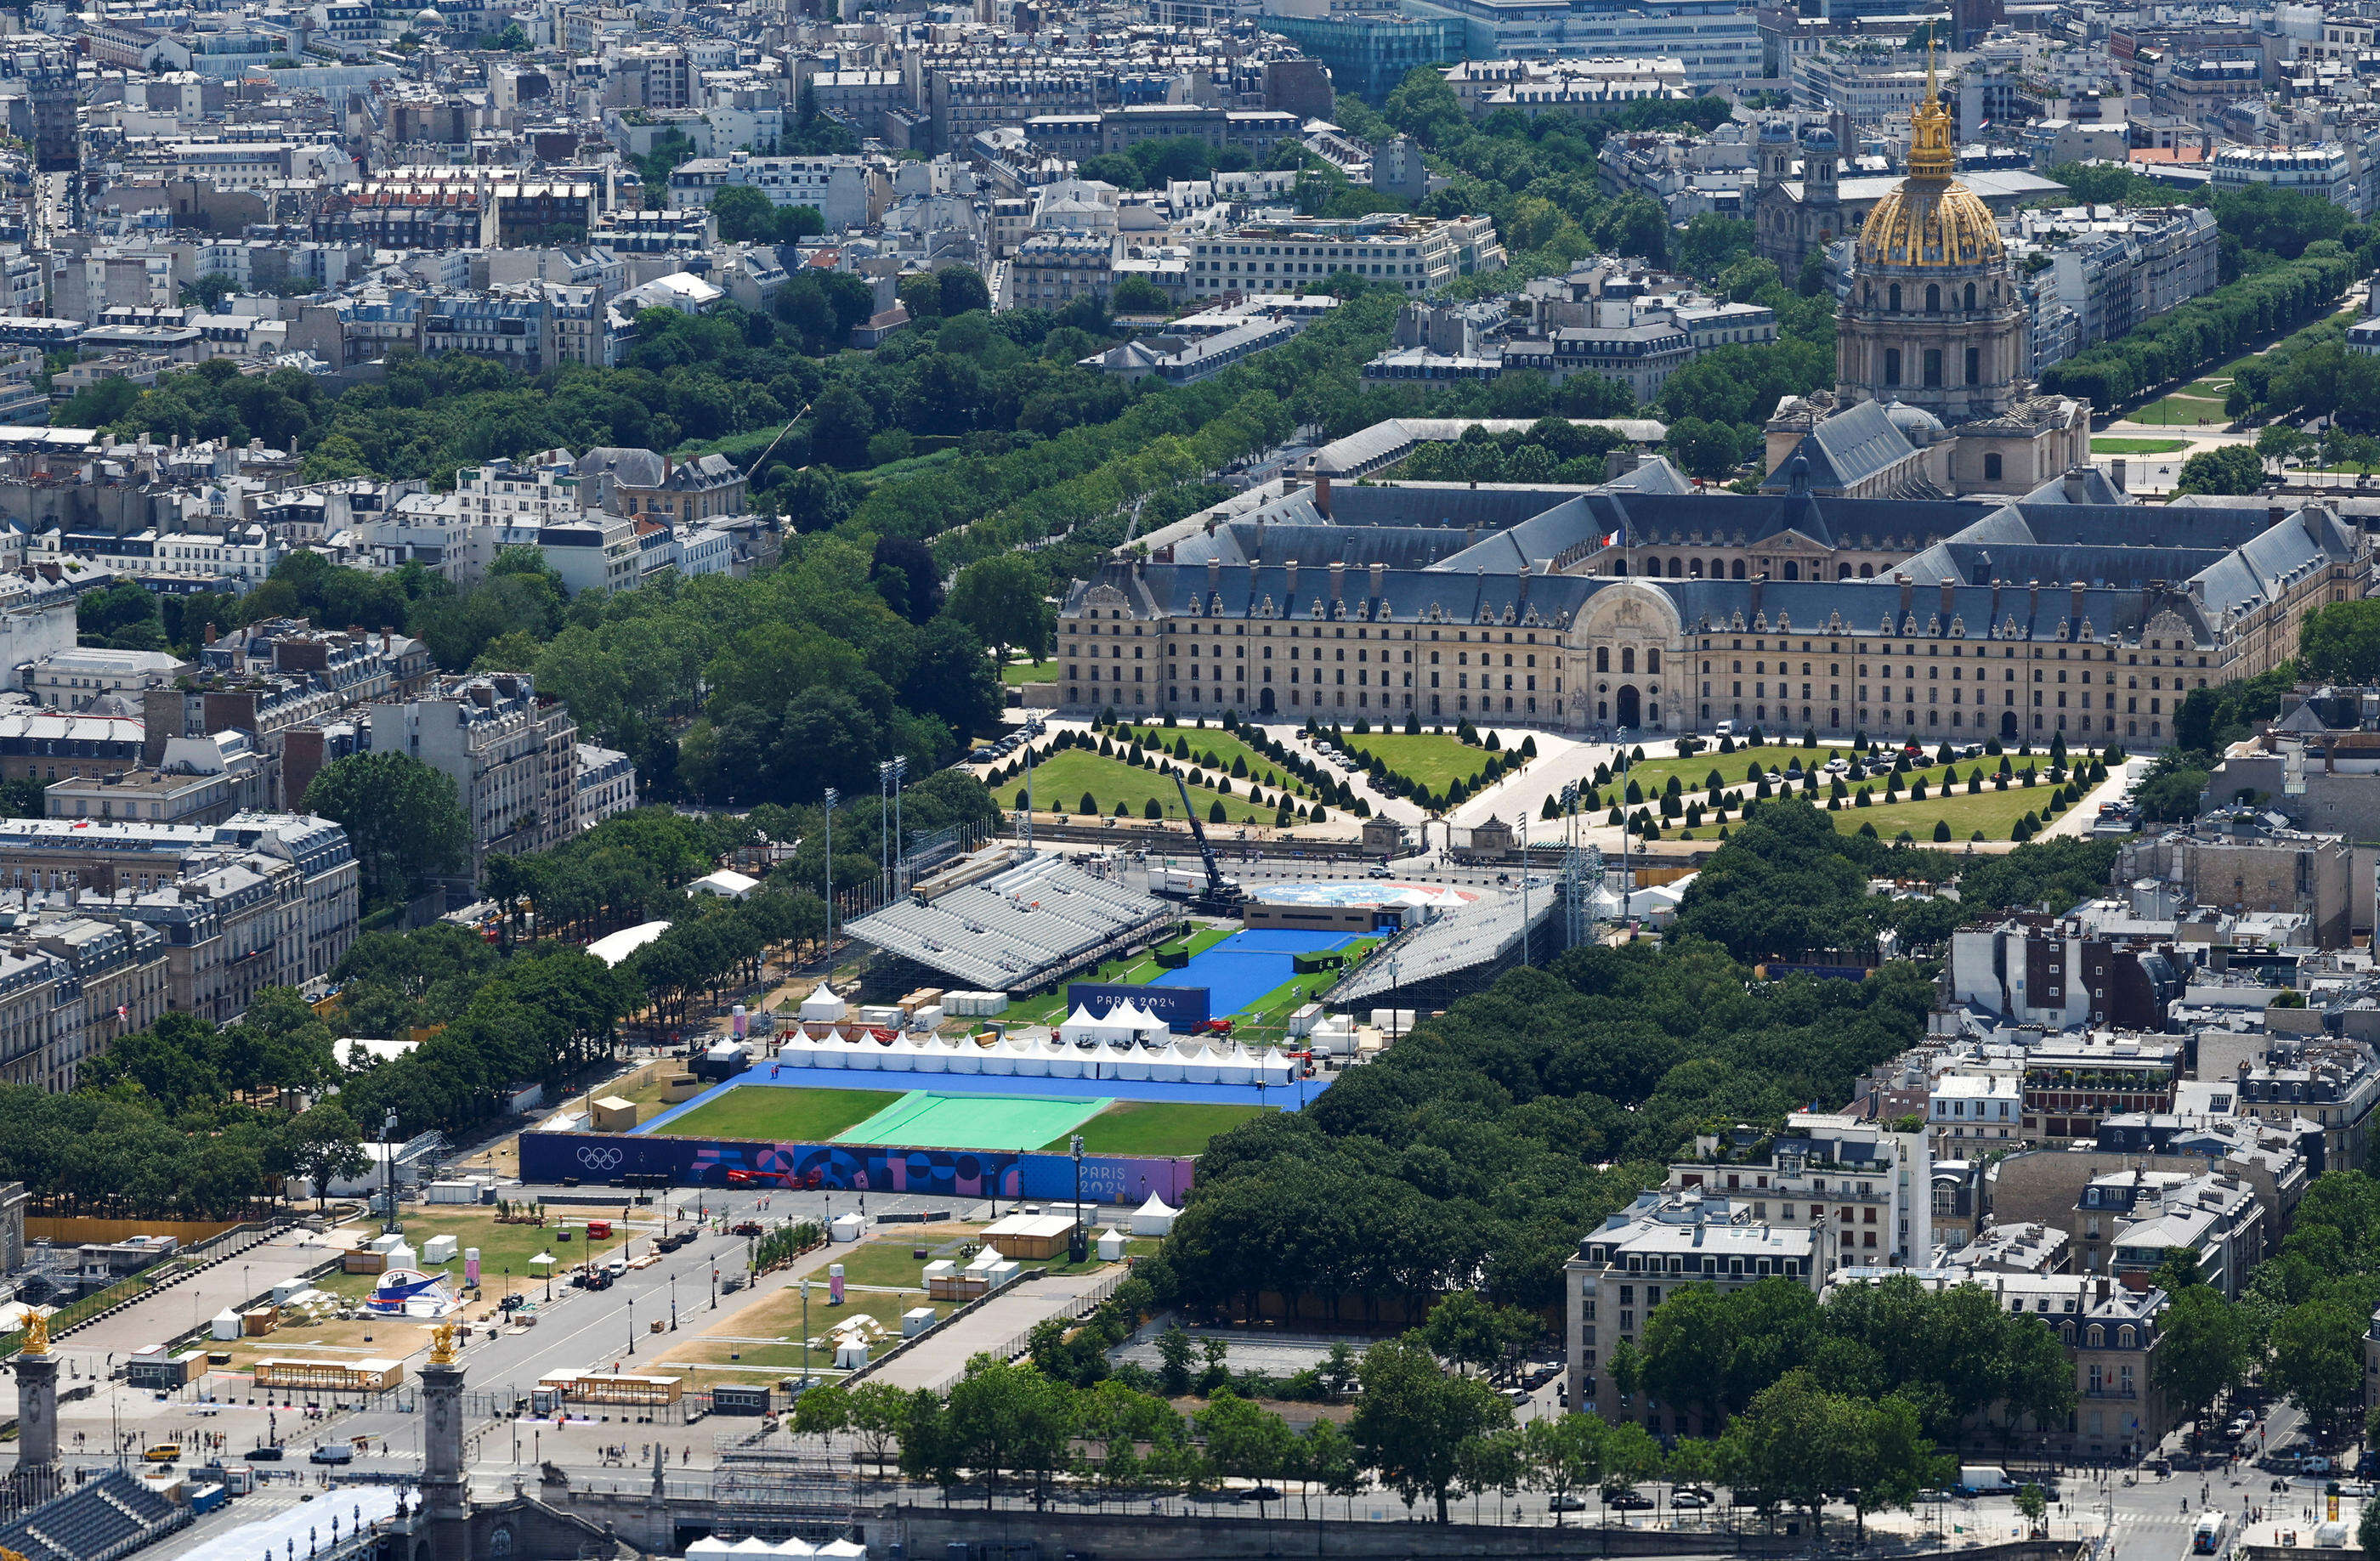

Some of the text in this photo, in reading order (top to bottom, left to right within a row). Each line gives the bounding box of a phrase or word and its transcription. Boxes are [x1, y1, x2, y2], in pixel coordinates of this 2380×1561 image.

[1096, 995, 1175, 1008] PARS 2024
[1080, 1166, 1125, 1179] PARIS
[1080, 1180, 1125, 1194] 2024
